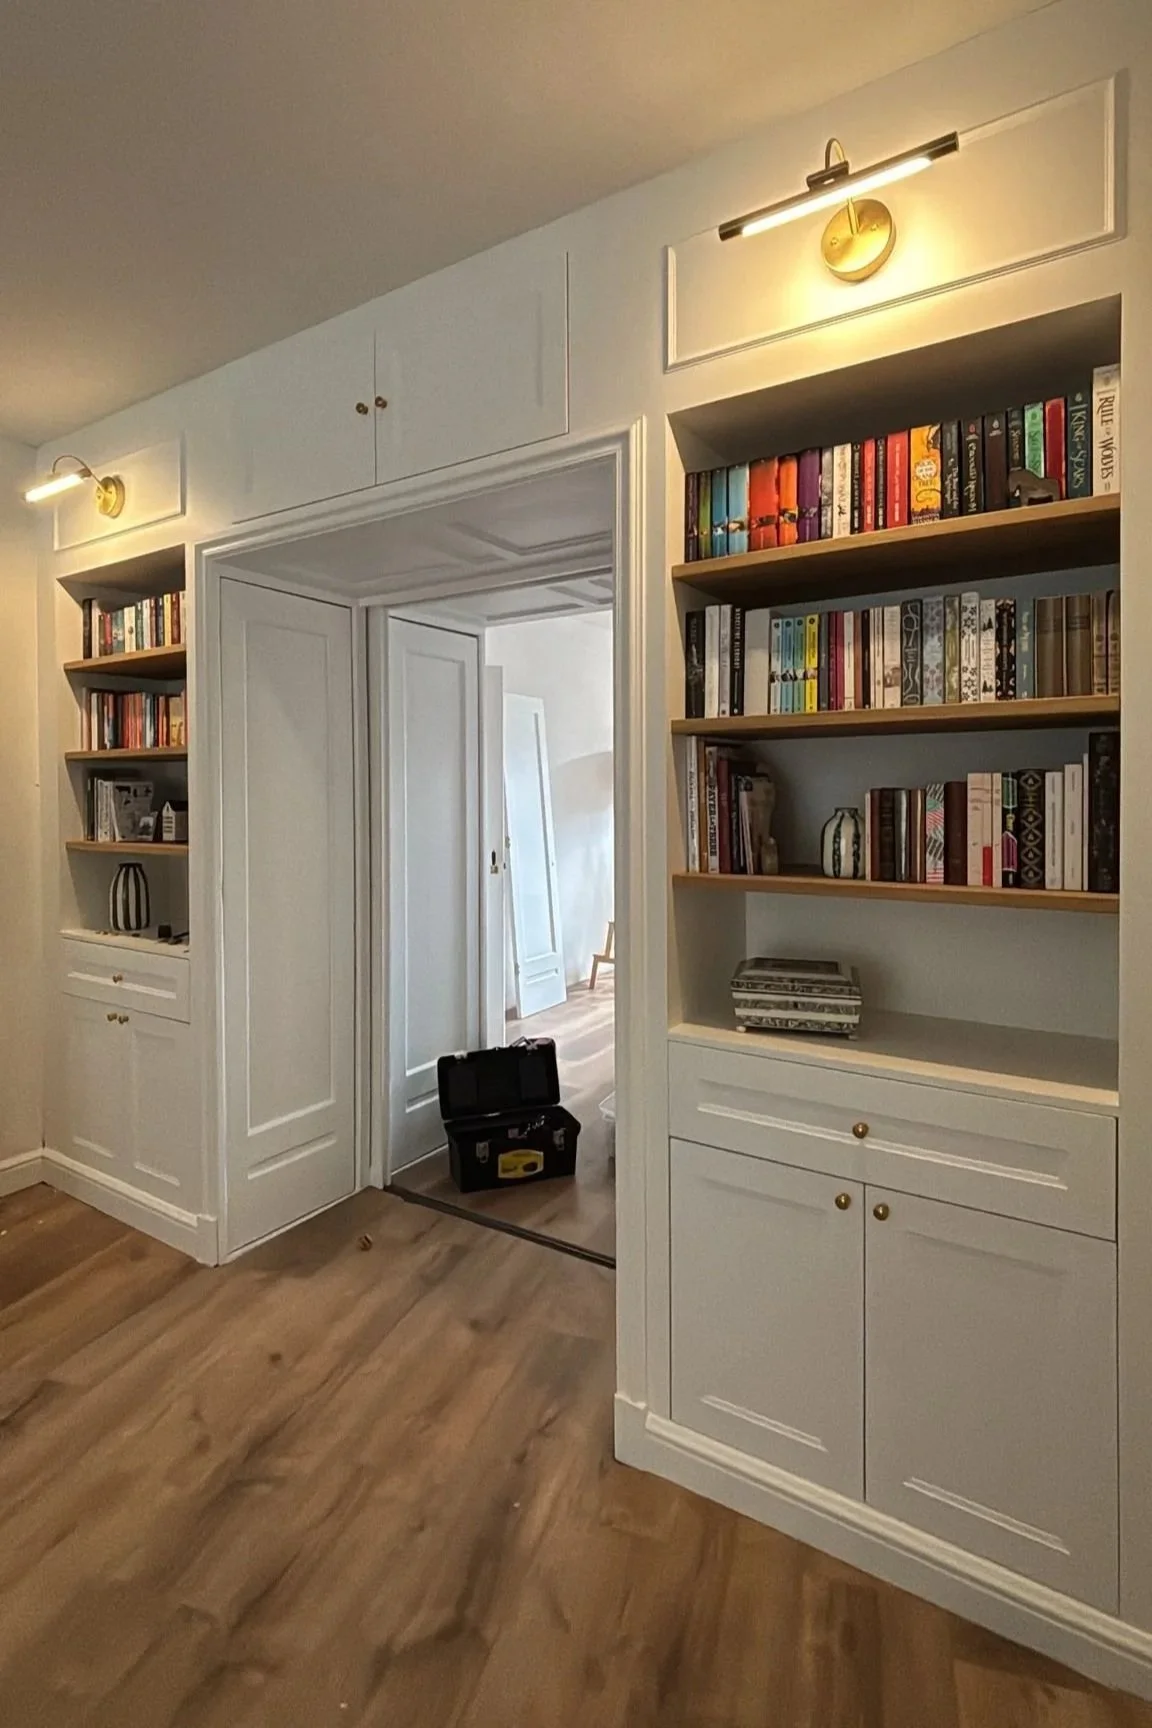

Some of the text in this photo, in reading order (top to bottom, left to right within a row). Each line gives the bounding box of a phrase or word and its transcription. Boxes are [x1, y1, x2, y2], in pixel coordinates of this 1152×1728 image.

[1071, 410, 1087, 441] KING
[1097, 394, 1115, 427] RULE
[1070, 450, 1087, 489] SCARS
[1099, 437, 1115, 480] WOLVES
[708, 784, 716, 816] PAYER
[709, 826, 717, 857] TERRE
